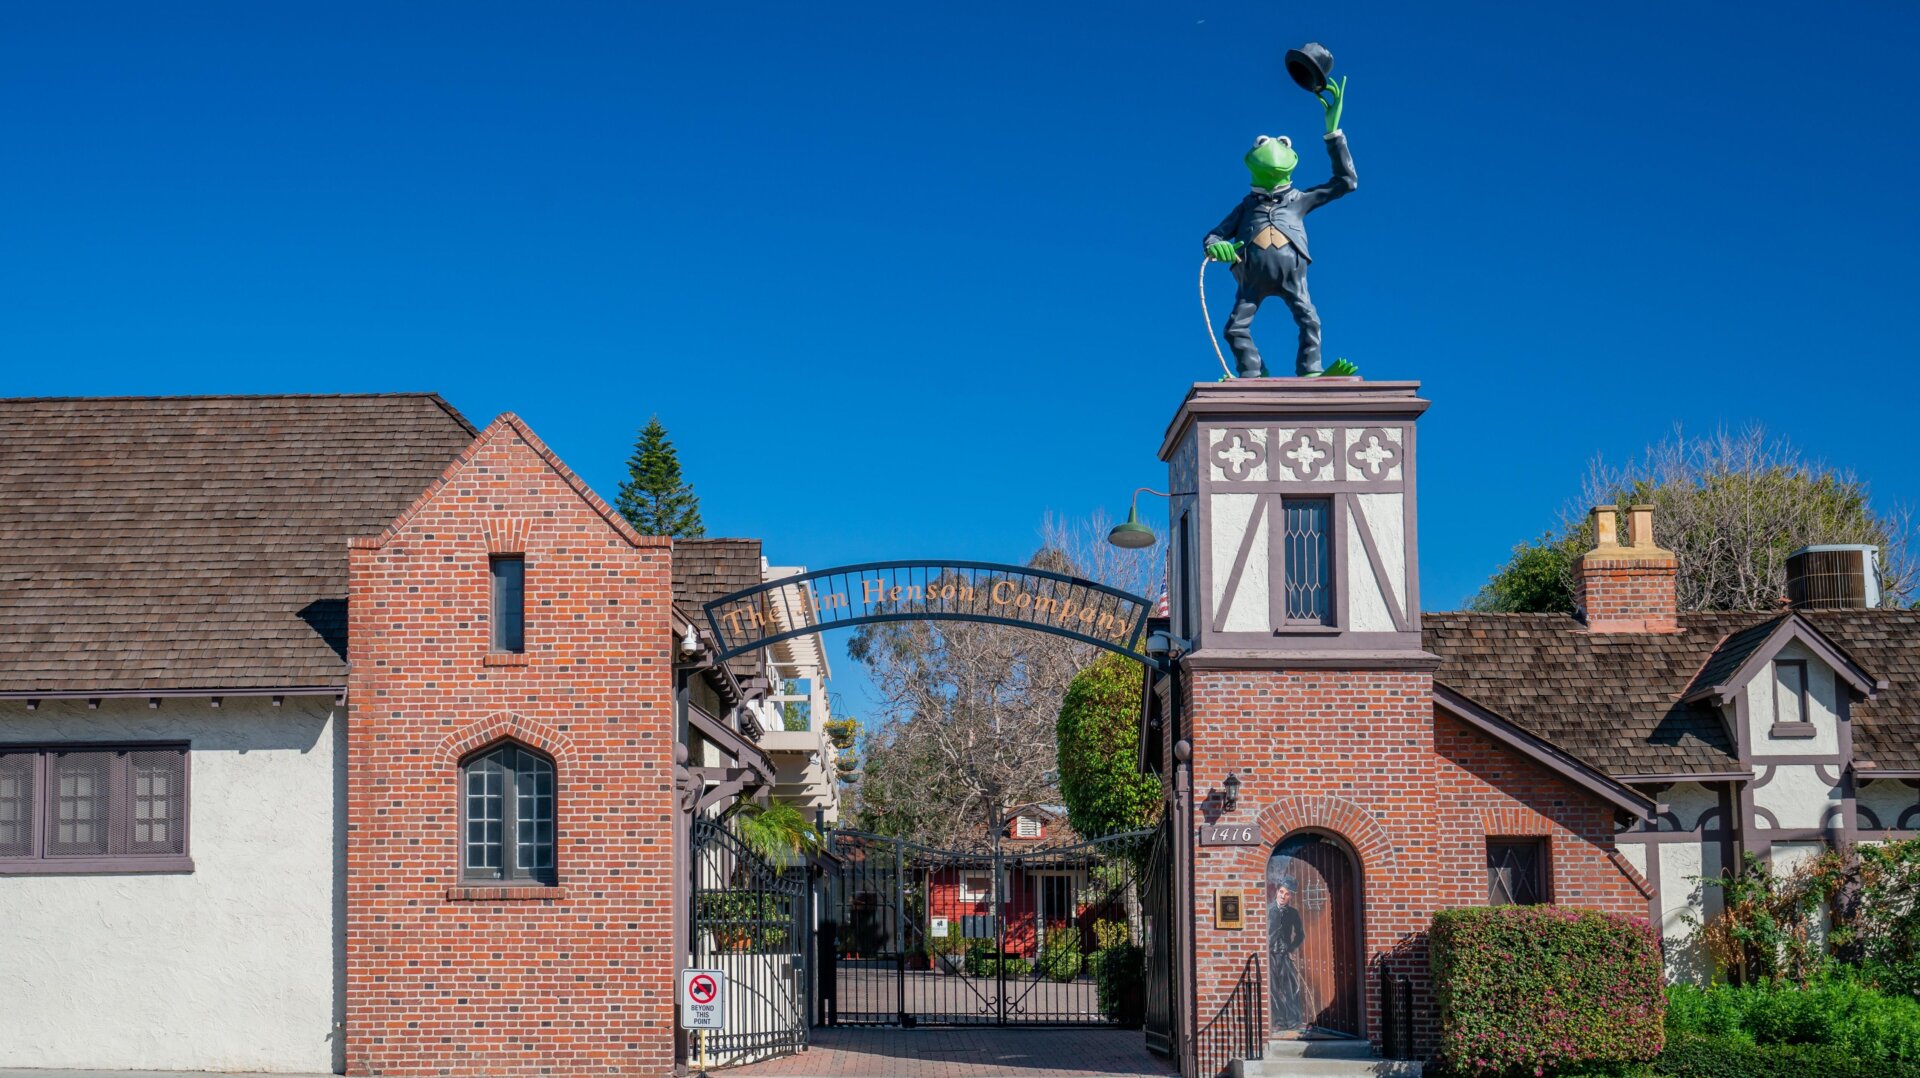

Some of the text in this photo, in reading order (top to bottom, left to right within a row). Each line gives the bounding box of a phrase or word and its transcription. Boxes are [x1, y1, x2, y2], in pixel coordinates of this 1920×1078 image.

[723, 578, 1132, 638] The Jim Henson Company
[1211, 828, 1252, 841] 1416
